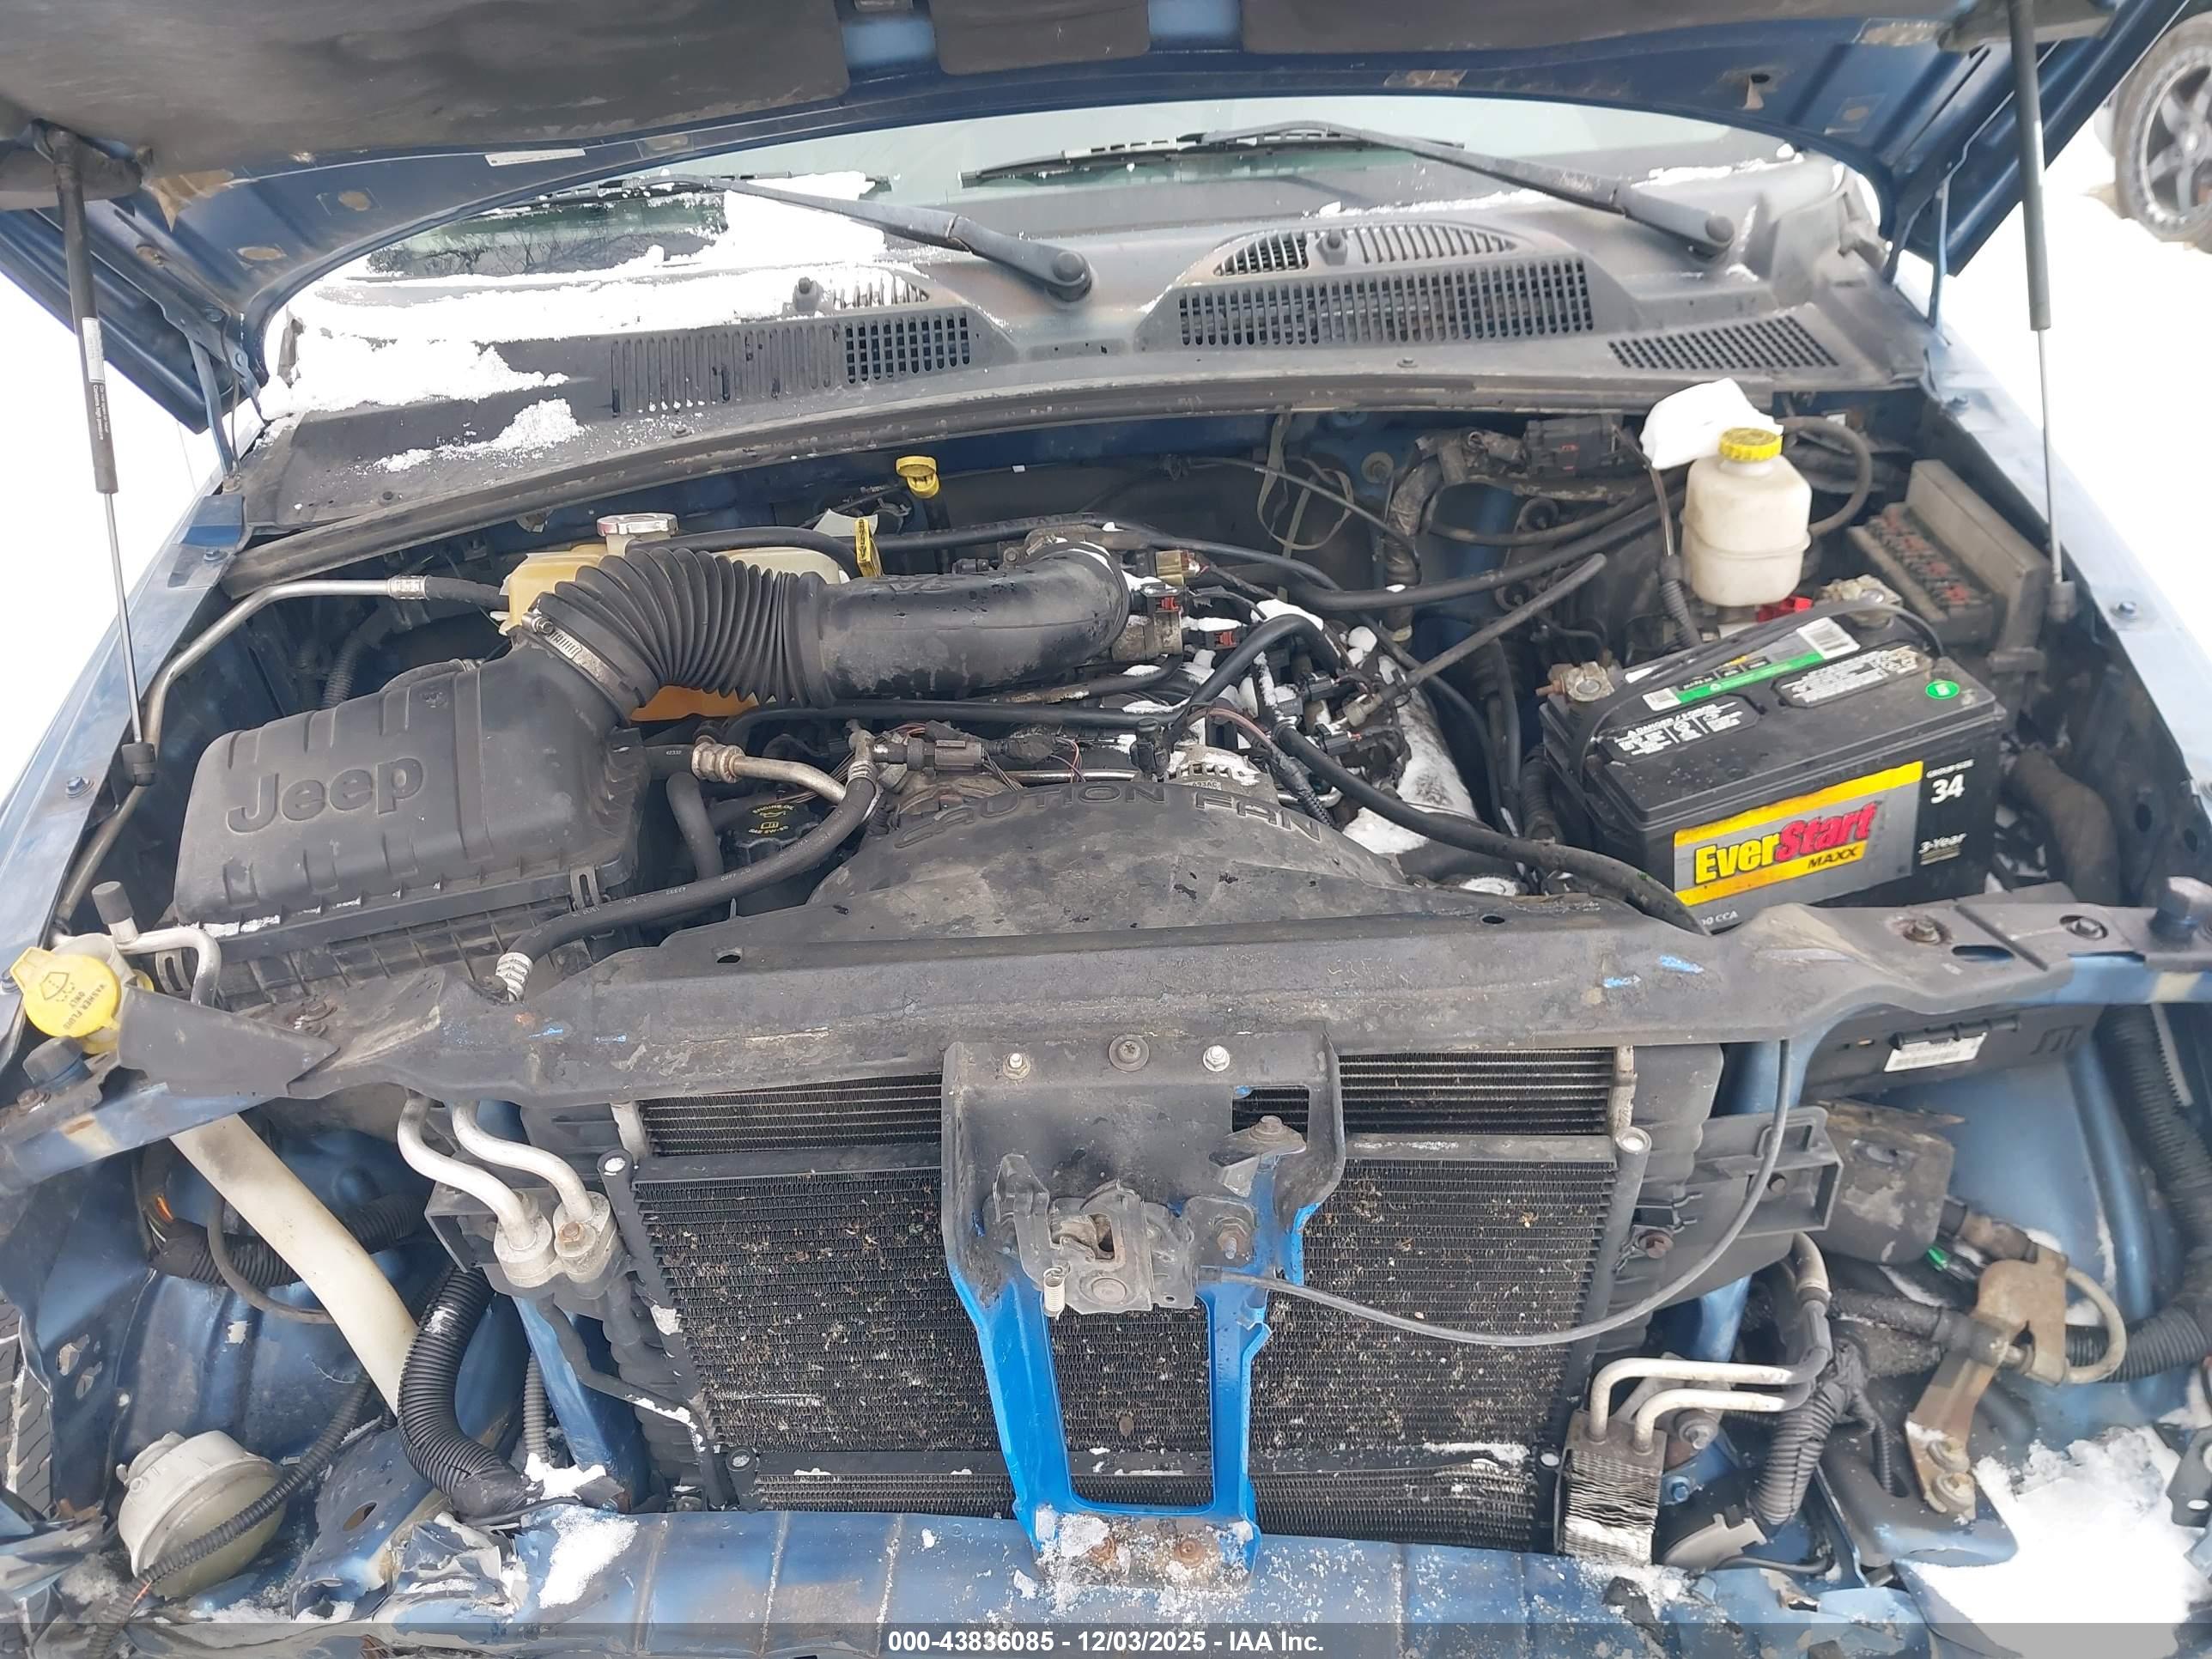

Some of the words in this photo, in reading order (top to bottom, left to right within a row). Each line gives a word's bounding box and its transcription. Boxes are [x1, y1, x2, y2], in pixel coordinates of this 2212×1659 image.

[227, 758, 423, 833] Jeep
[1930, 774, 1966, 804] 34
[894, 785, 1165, 848] CAUTION
[1194, 790, 1322, 842] FAN
[1695, 800, 1878, 885] EverStart
[1807, 845, 1858, 870] MAXX
[1714, 910, 1738, 924] CCA
